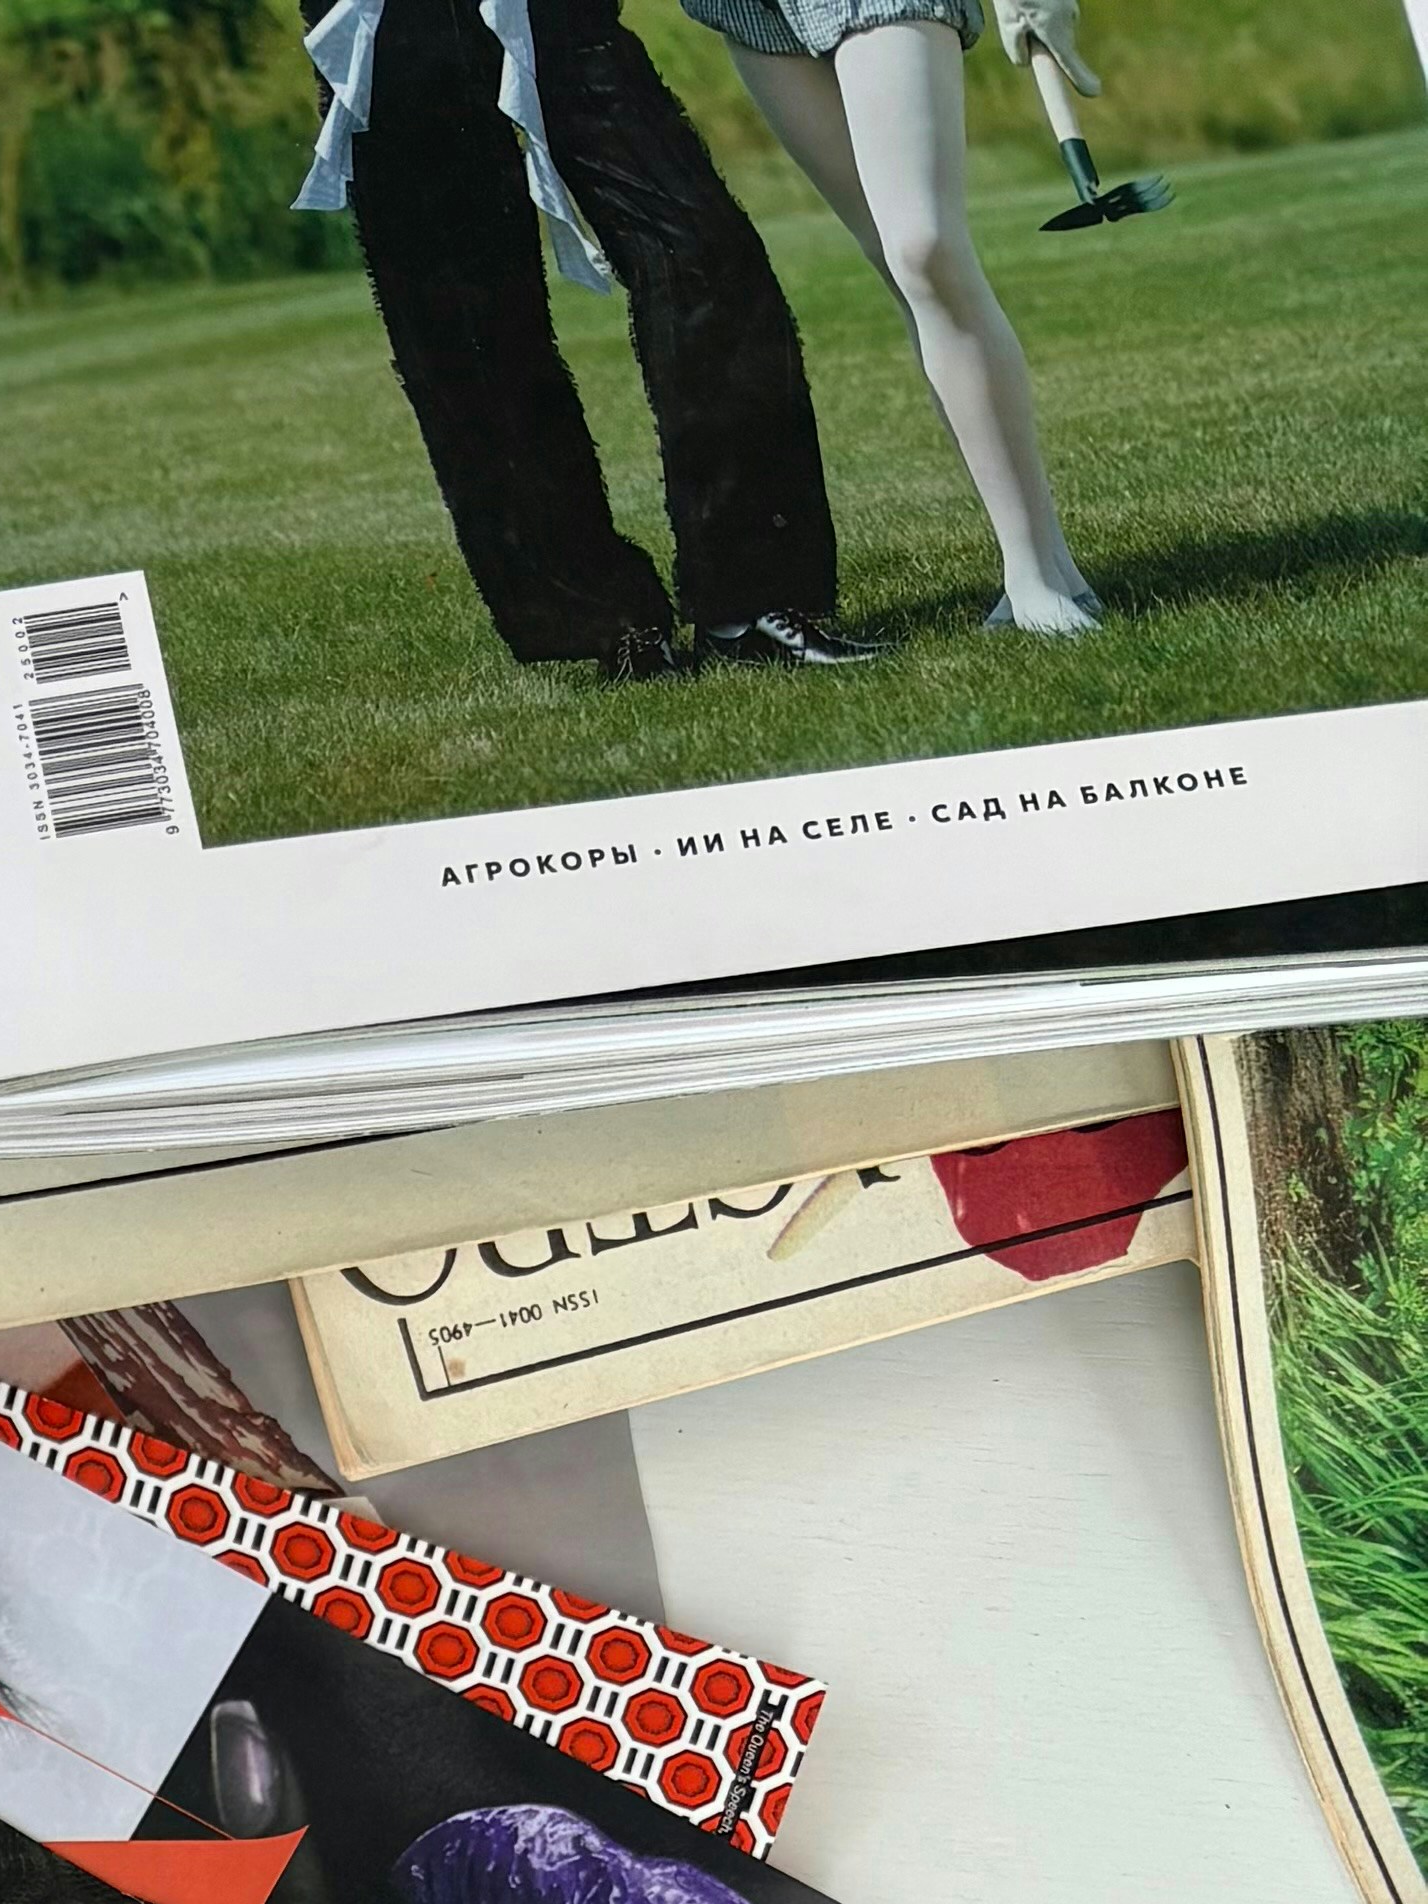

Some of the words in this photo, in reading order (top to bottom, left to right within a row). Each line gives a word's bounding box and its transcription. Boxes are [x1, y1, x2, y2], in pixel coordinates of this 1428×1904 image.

[12, 703, 41, 791] 3034-7041
[32, 800, 51, 841] ISSN
[439, 842, 638, 887] АГРОКОРЫ
[676, 831, 727, 858] ИИ
[739, 825, 789, 849] НА
[802, 809, 895, 841] СЕЛЕ
[931, 795, 1007, 825] САД
[1020, 788, 1068, 814] НА
[1080, 764, 1250, 806] БАЛКОНЕ
[552, 1289, 600, 1315] ISSN
